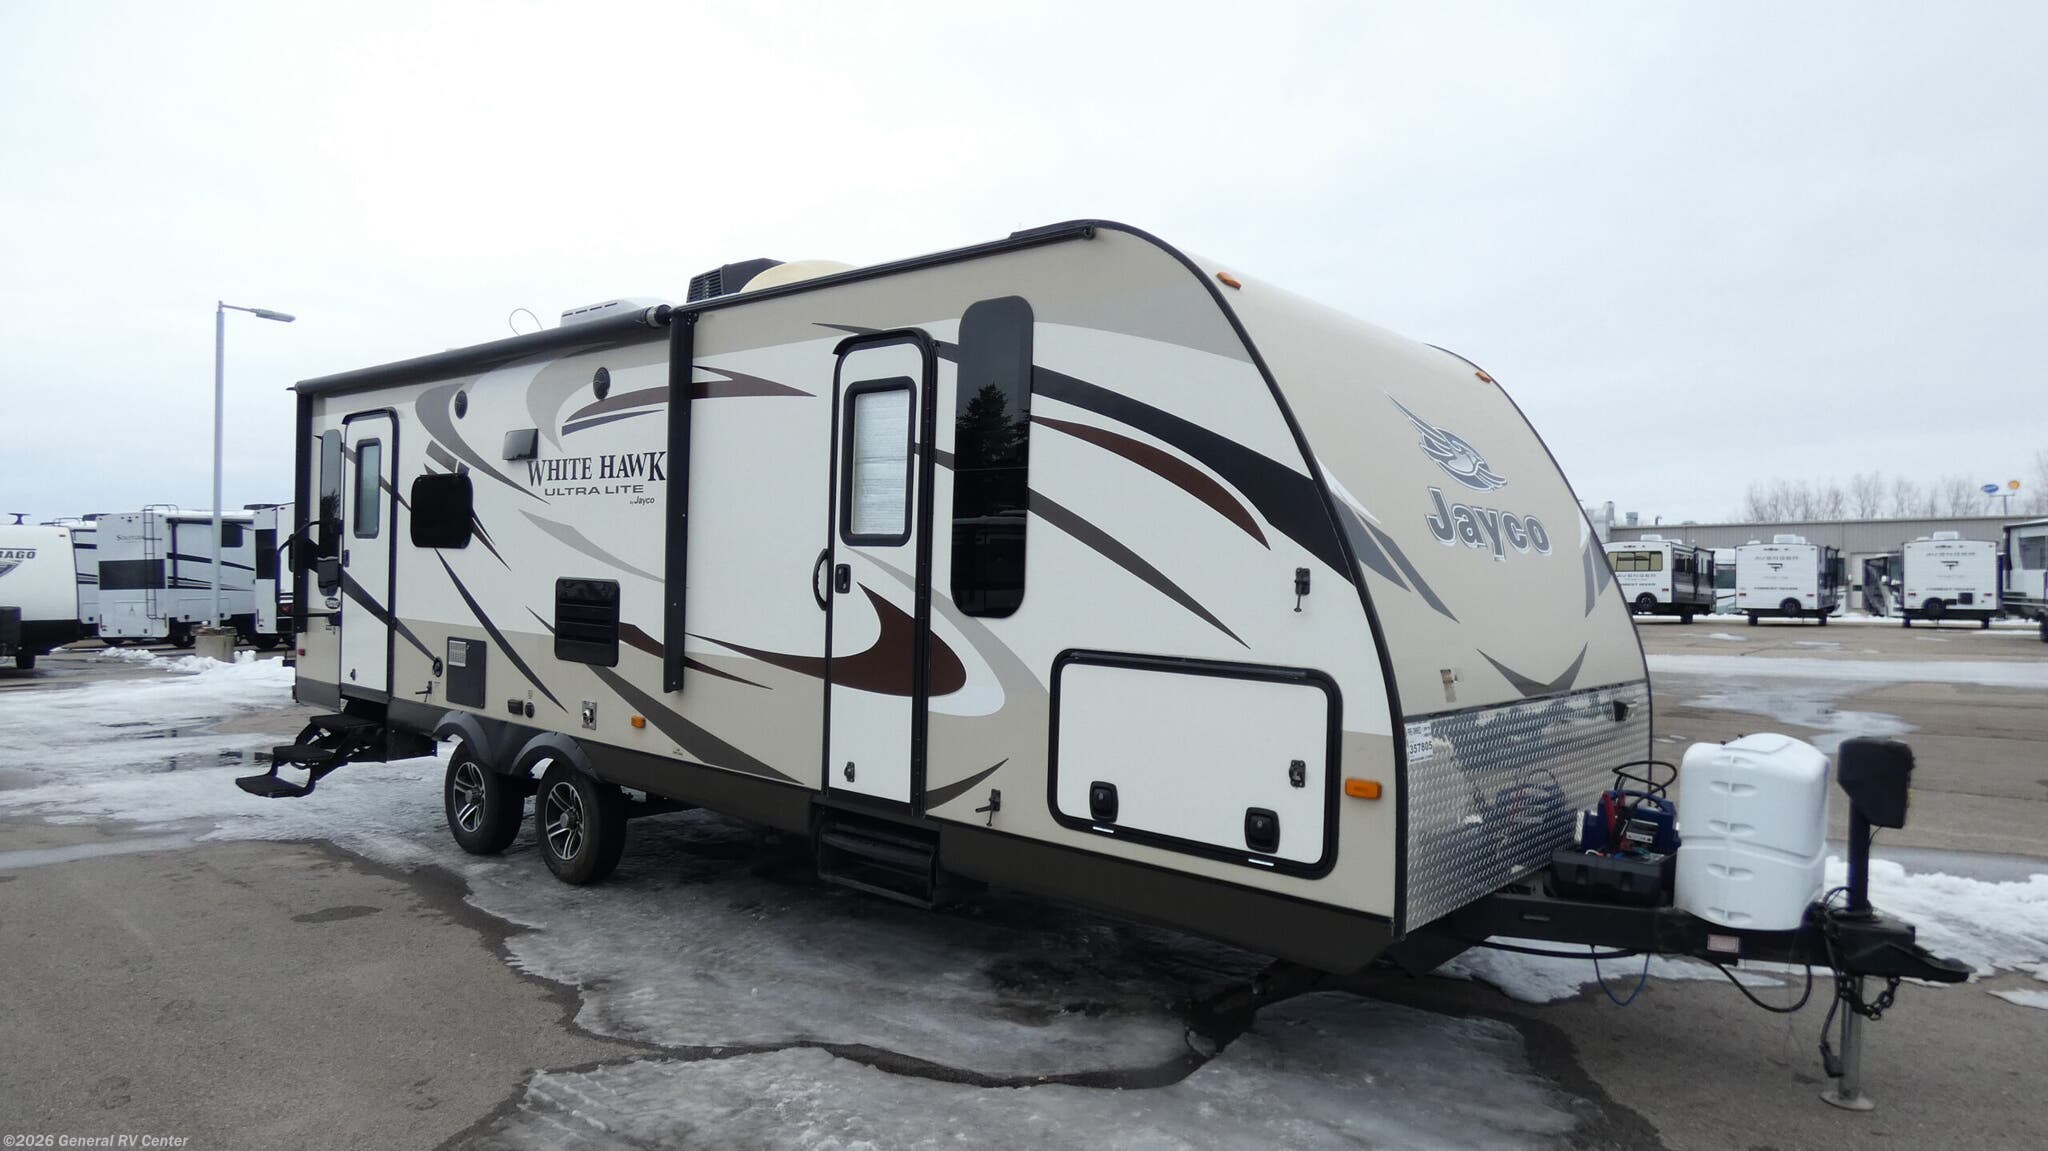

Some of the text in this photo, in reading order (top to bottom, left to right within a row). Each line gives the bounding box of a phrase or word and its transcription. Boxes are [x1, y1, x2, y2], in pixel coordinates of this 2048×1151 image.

[527, 451, 666, 487] WHITE HAWK
[544, 484, 644, 496] ULTRA LITE
[634, 496, 655, 506] Jayco
[1425, 486, 1552, 563] Jayco
